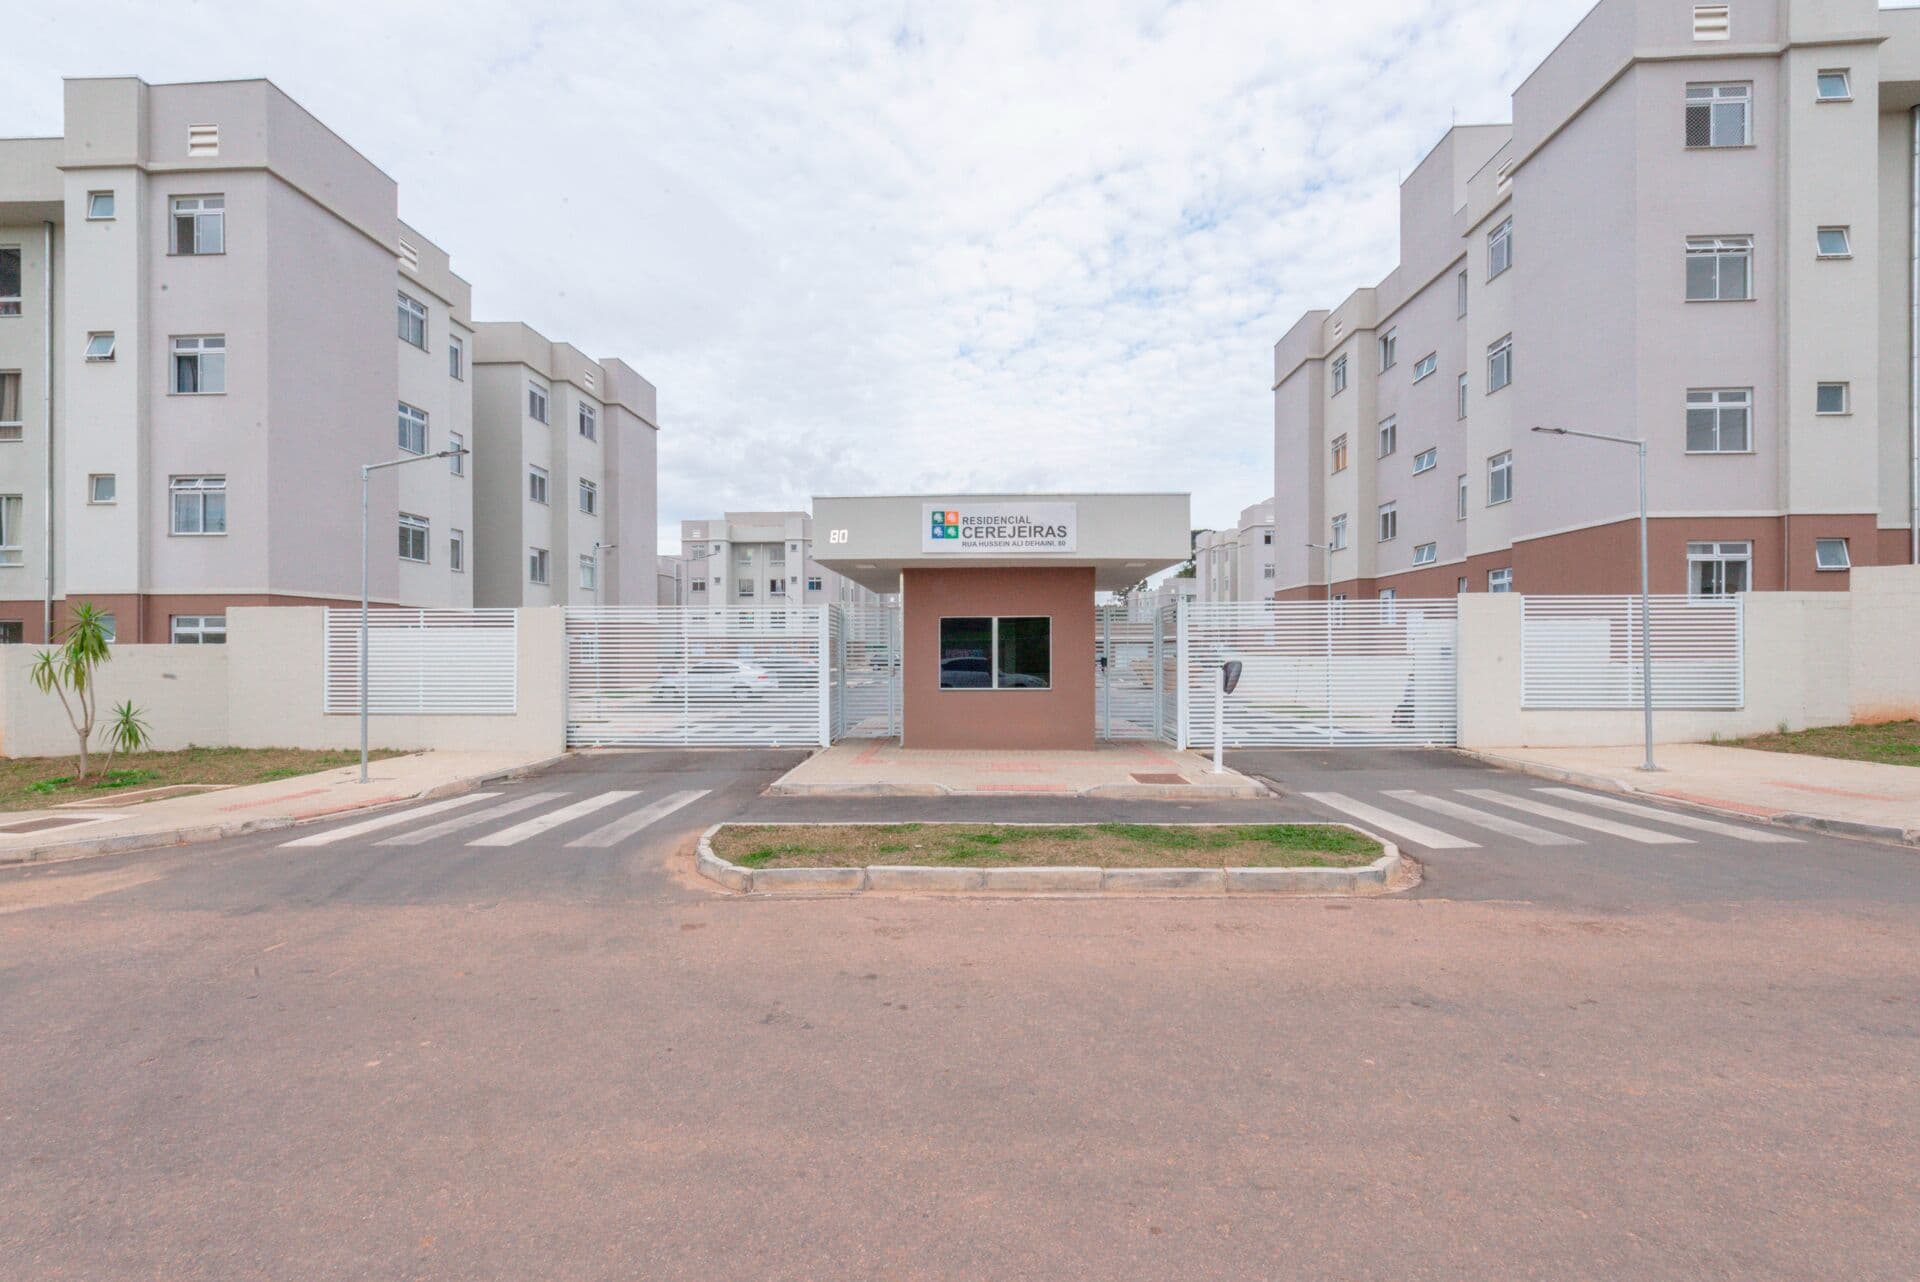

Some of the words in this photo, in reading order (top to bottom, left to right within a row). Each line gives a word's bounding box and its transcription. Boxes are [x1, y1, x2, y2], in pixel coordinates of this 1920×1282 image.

[962, 516, 1031, 525] RESIDENCIAL
[830, 529, 848, 544] 80
[962, 525, 1067, 539] CEREJEIRAS
